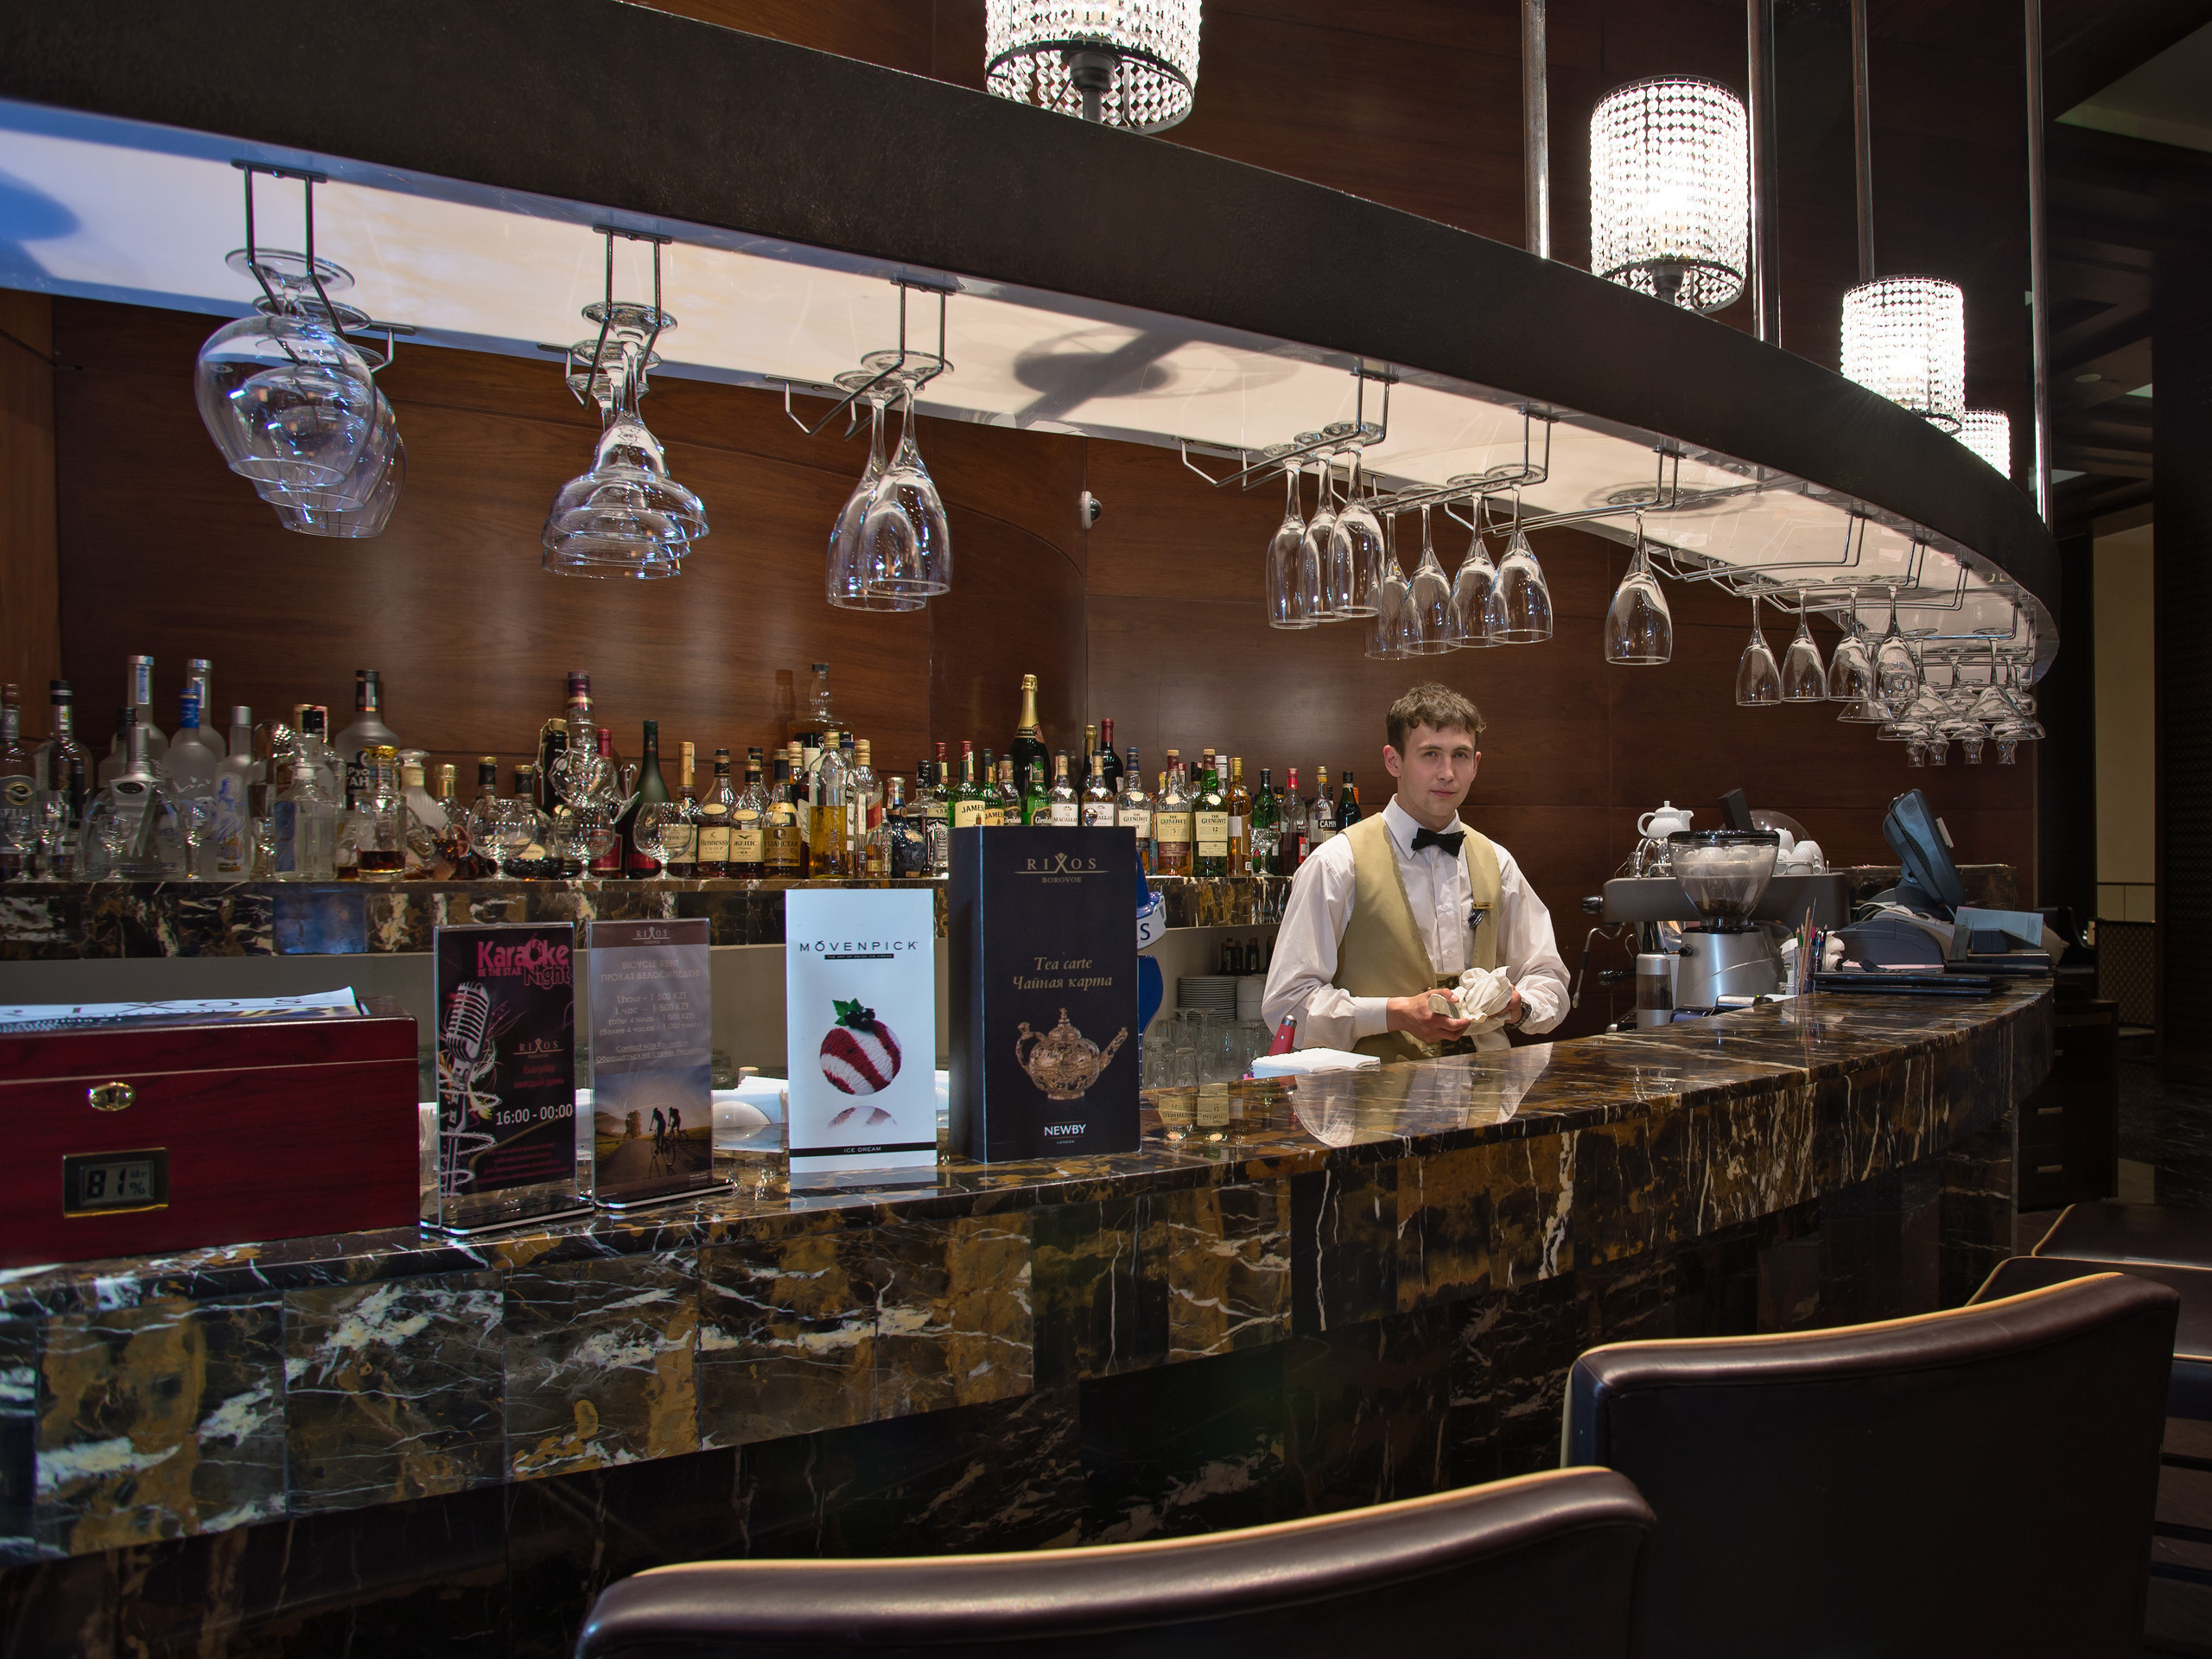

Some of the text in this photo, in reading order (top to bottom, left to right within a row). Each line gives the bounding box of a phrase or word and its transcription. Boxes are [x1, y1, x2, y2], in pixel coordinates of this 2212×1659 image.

[1027, 852, 1096, 872] RIXOS
[636, 926, 669, 938] RIXOS
[622, 959, 679, 969] BICYCLE RENT
[1034, 957, 1093, 971] Tea carte
[477, 966, 523, 977] BE THE STAR
[524, 964, 570, 989] Night
[601, 969, 700, 982] ПРОКАТ ВЕЛОСИПЕДОВ
[1012, 975, 1113, 991] Чайная карта
[519, 1038, 559, 1052] RIXOS
[616, 1044, 643, 1052] Contact
[496, 1108, 531, 1126] 16:00
[540, 1103, 574, 1121] 00:00
[1044, 1124, 1087, 1136] NEWBY
